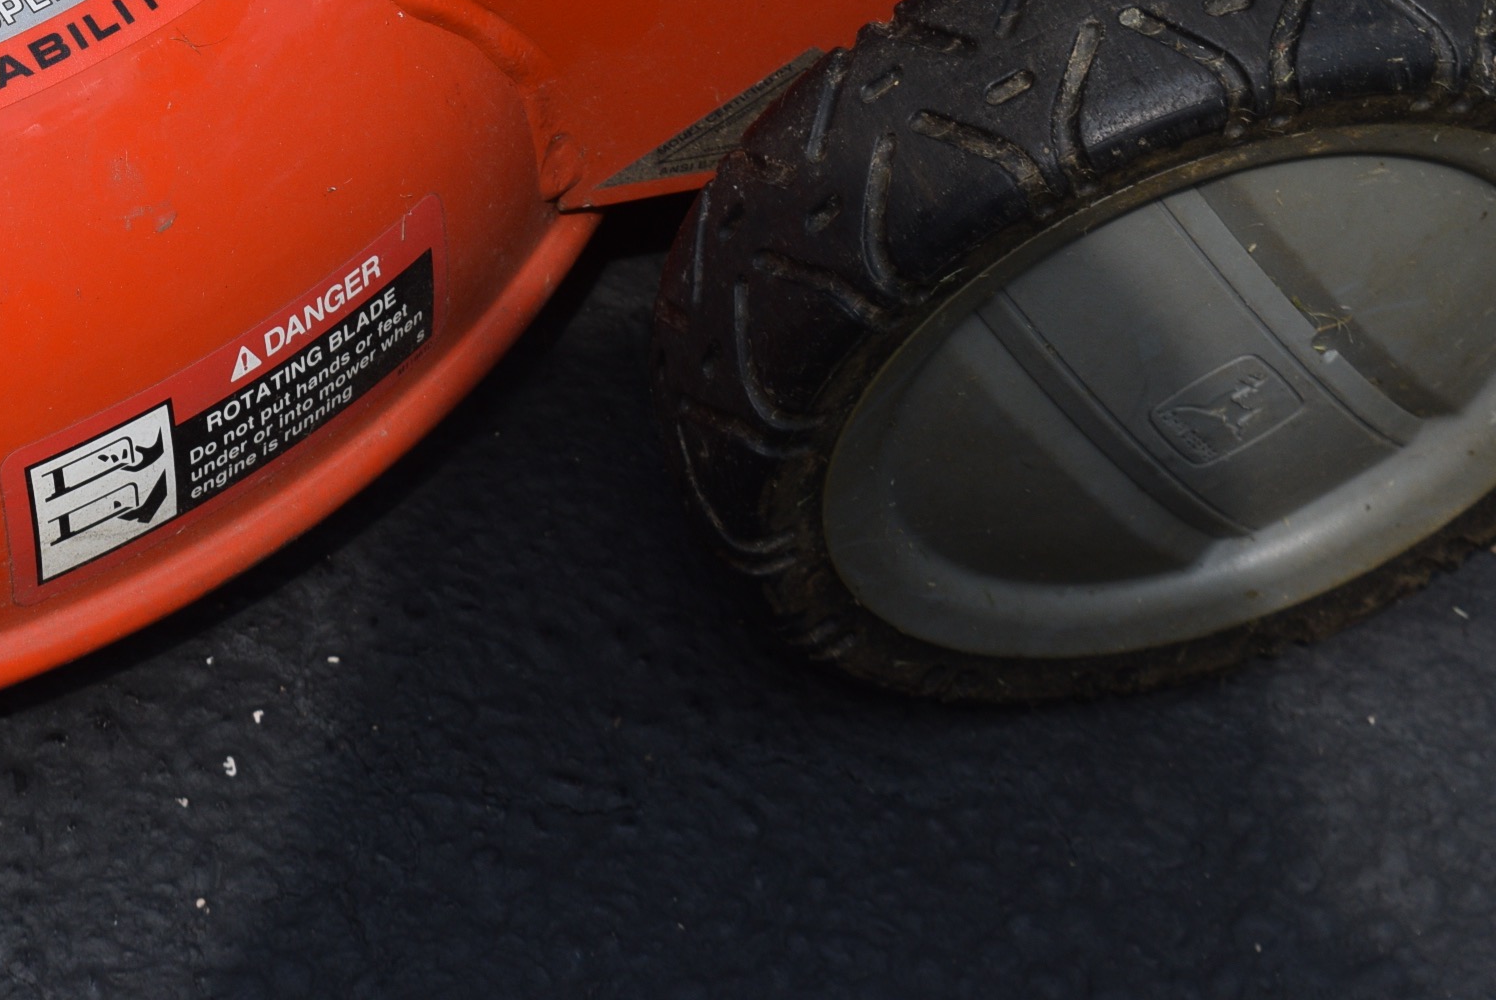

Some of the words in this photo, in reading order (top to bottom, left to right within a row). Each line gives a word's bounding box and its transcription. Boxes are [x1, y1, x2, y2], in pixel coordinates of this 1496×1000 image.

[206, 346, 323, 433] ROTATING
[329, 286, 398, 352] BLADE
[262, 255, 381, 357] DANGER
[190, 440, 217, 466] Do
[223, 413, 255, 445] not
[260, 393, 292, 431] put
[295, 352, 351, 399] hands
[355, 334, 374, 356] or
[376, 303, 409, 343] feet
[190, 445, 247, 483] under
[253, 424, 277, 446] or
[278, 399, 315, 436] into
[318, 354, 377, 405] mower
[380, 309, 424, 353] when
[190, 453, 258, 501] engine
[261, 434, 279, 457] is
[283, 385, 354, 443] running
